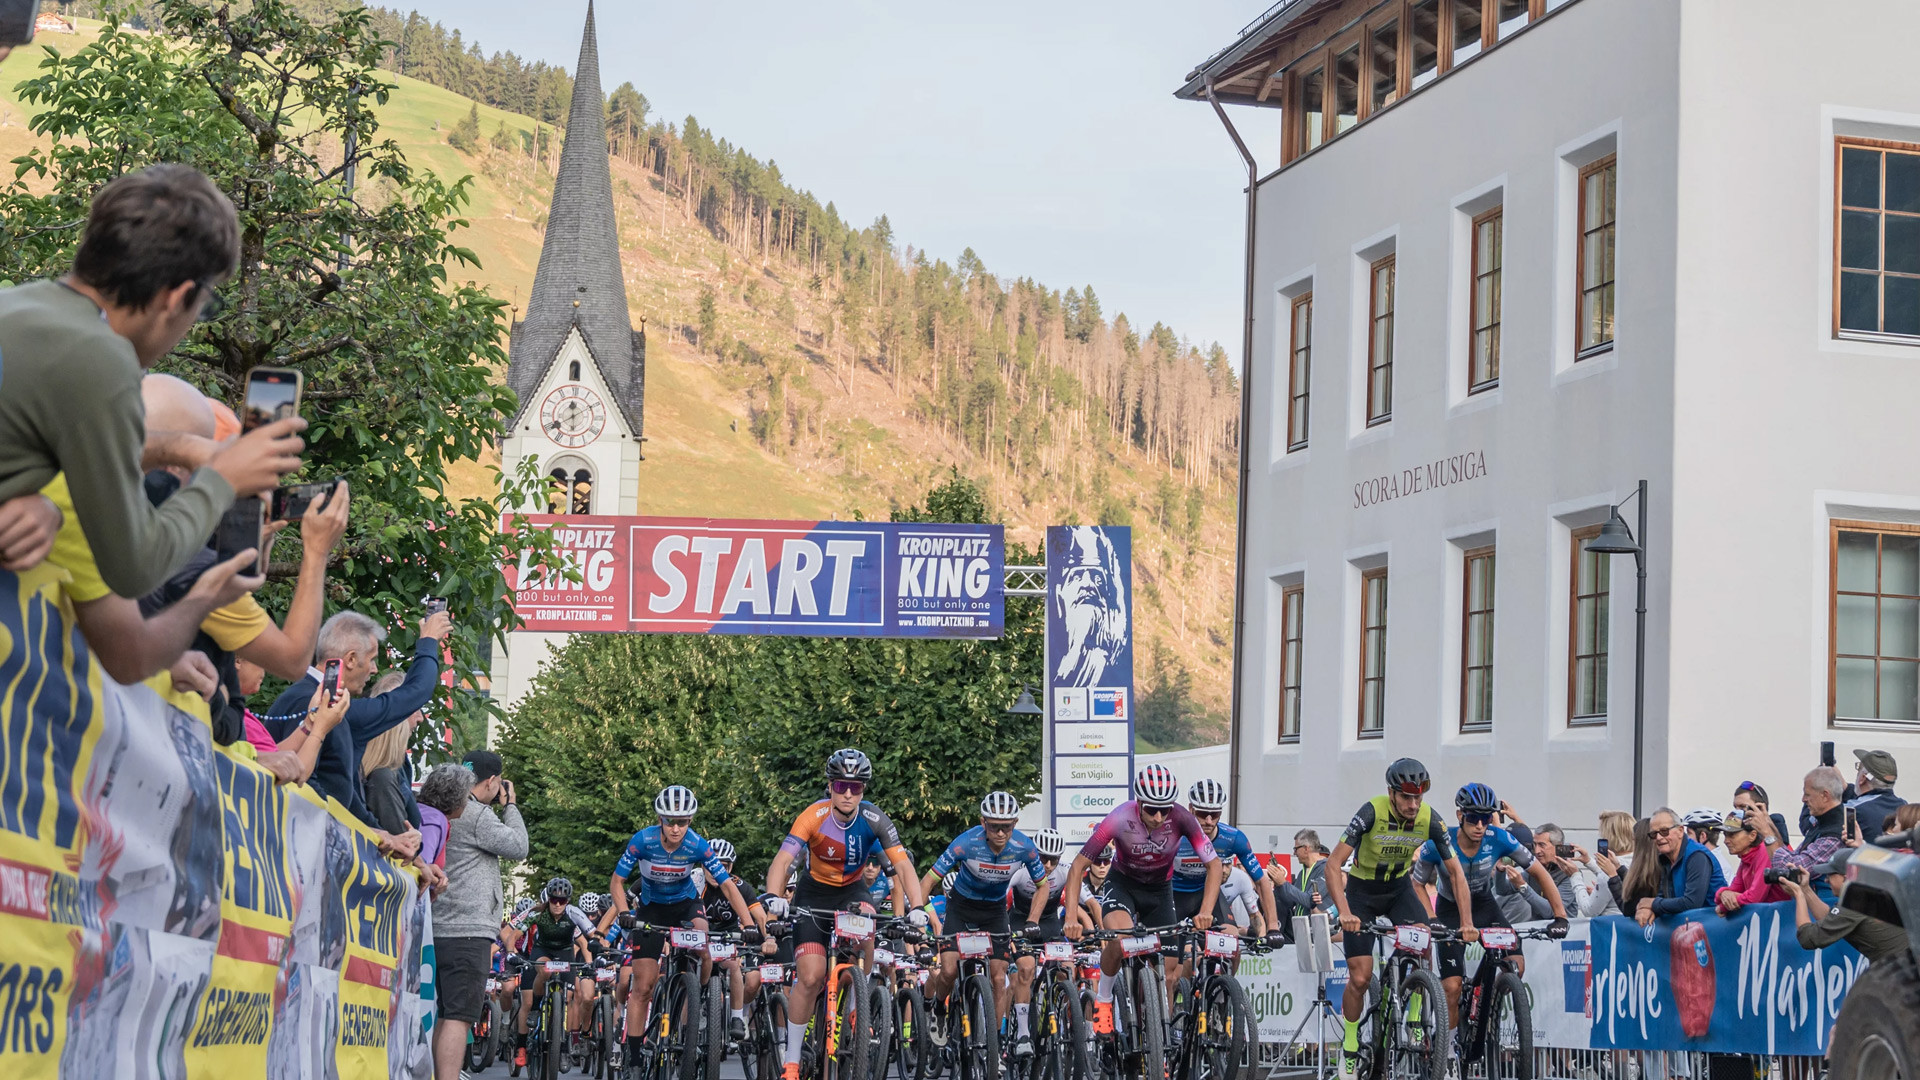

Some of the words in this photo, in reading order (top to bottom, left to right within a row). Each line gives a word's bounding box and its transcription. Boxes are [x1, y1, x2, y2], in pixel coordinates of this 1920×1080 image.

[1353, 473, 1399, 509] SCORA
[1402, 466, 1422, 497] DE
[1425, 449, 1488, 490] MUSIGA
[898, 536, 991, 557] KRONPLATZ
[516, 549, 615, 592] KING
[648, 534, 866, 616] START
[898, 557, 991, 599] KING
[516, 592, 538, 602] 800
[543, 592, 560, 602] but
[566, 592, 589, 605] only
[594, 595, 615, 603] one
[898, 598, 919, 609] 800
[923, 599, 940, 609] but
[944, 599, 967, 612] only
[971, 602, 991, 610] one
[1071, 770, 1087, 779] San
[1087, 769, 1114, 781] Vigilio
[1083, 795, 1115, 806] decor
[978, 867, 1010, 876] SOUDAL
[848, 916, 865, 928] 100
[680, 932, 698, 942] 106
[1218, 938, 1226, 947] 8
[1409, 931, 1420, 943] 13
[878, 951, 884, 959] 3
[1055, 945, 1064, 953] 15
[1562, 949, 1592, 965] KRONPLATZ
[766, 968, 778, 976] 102
[1594, 921, 1662, 1045] rlene
[193, 985, 271, 1047] GENERATORS
[341, 1002, 387, 1049] GENERATORS
